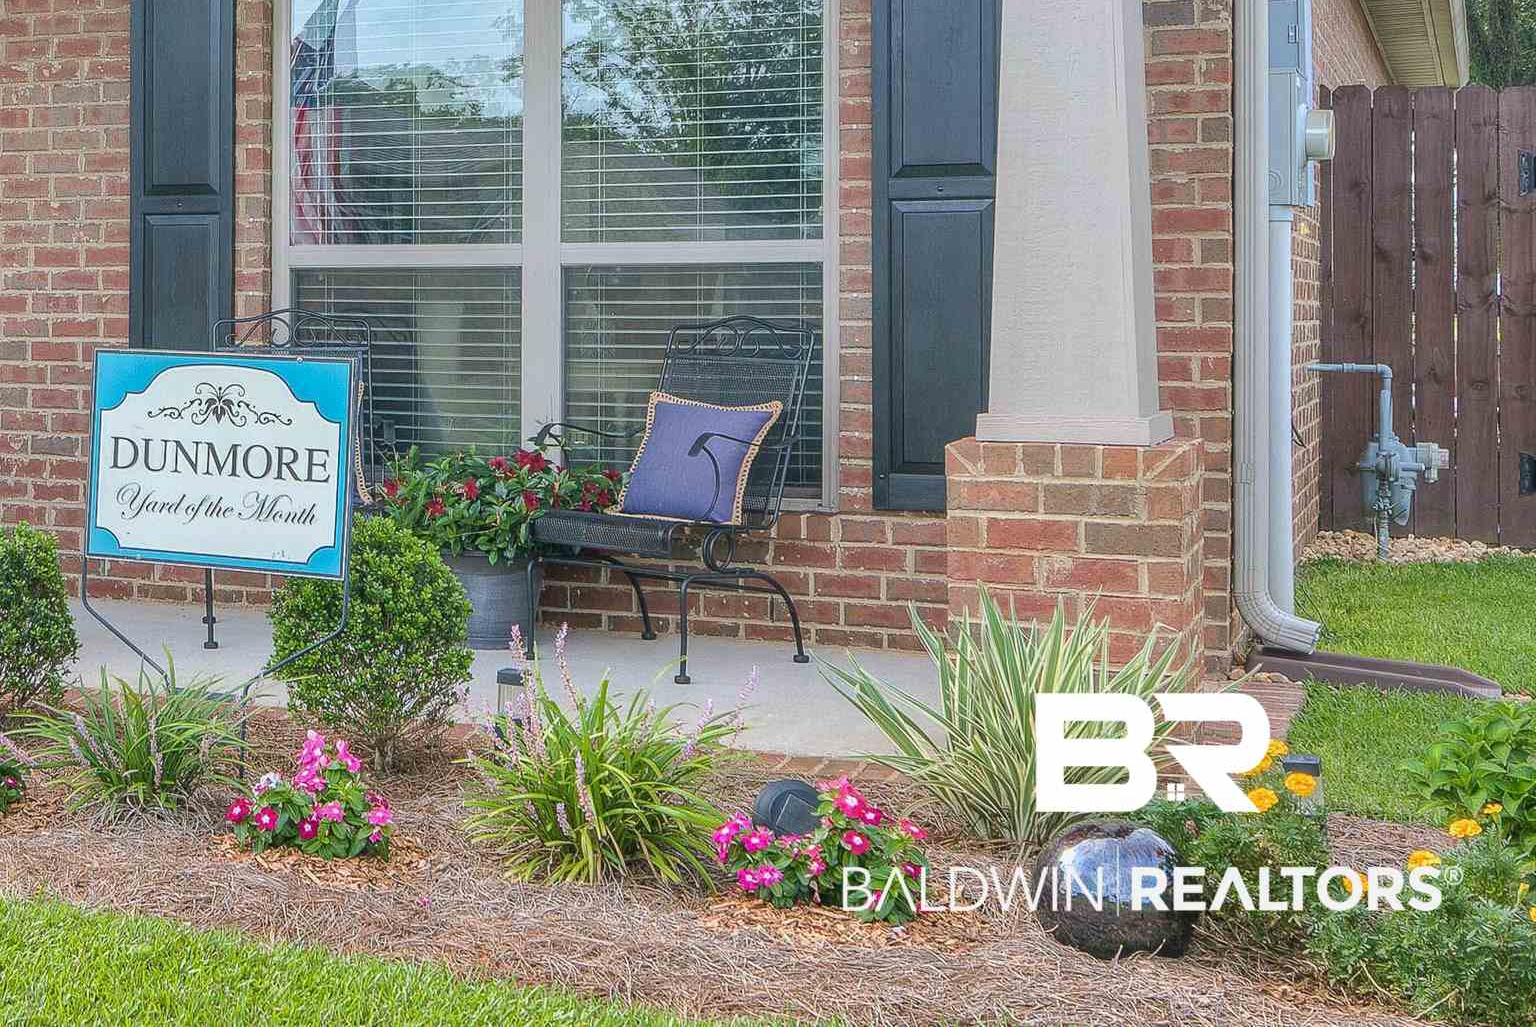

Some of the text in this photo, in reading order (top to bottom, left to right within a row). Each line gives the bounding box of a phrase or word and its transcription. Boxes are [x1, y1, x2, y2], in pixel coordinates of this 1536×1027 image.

[110, 436, 331, 483] DUNMORE
[116, 481, 317, 526] Yard of the Month
